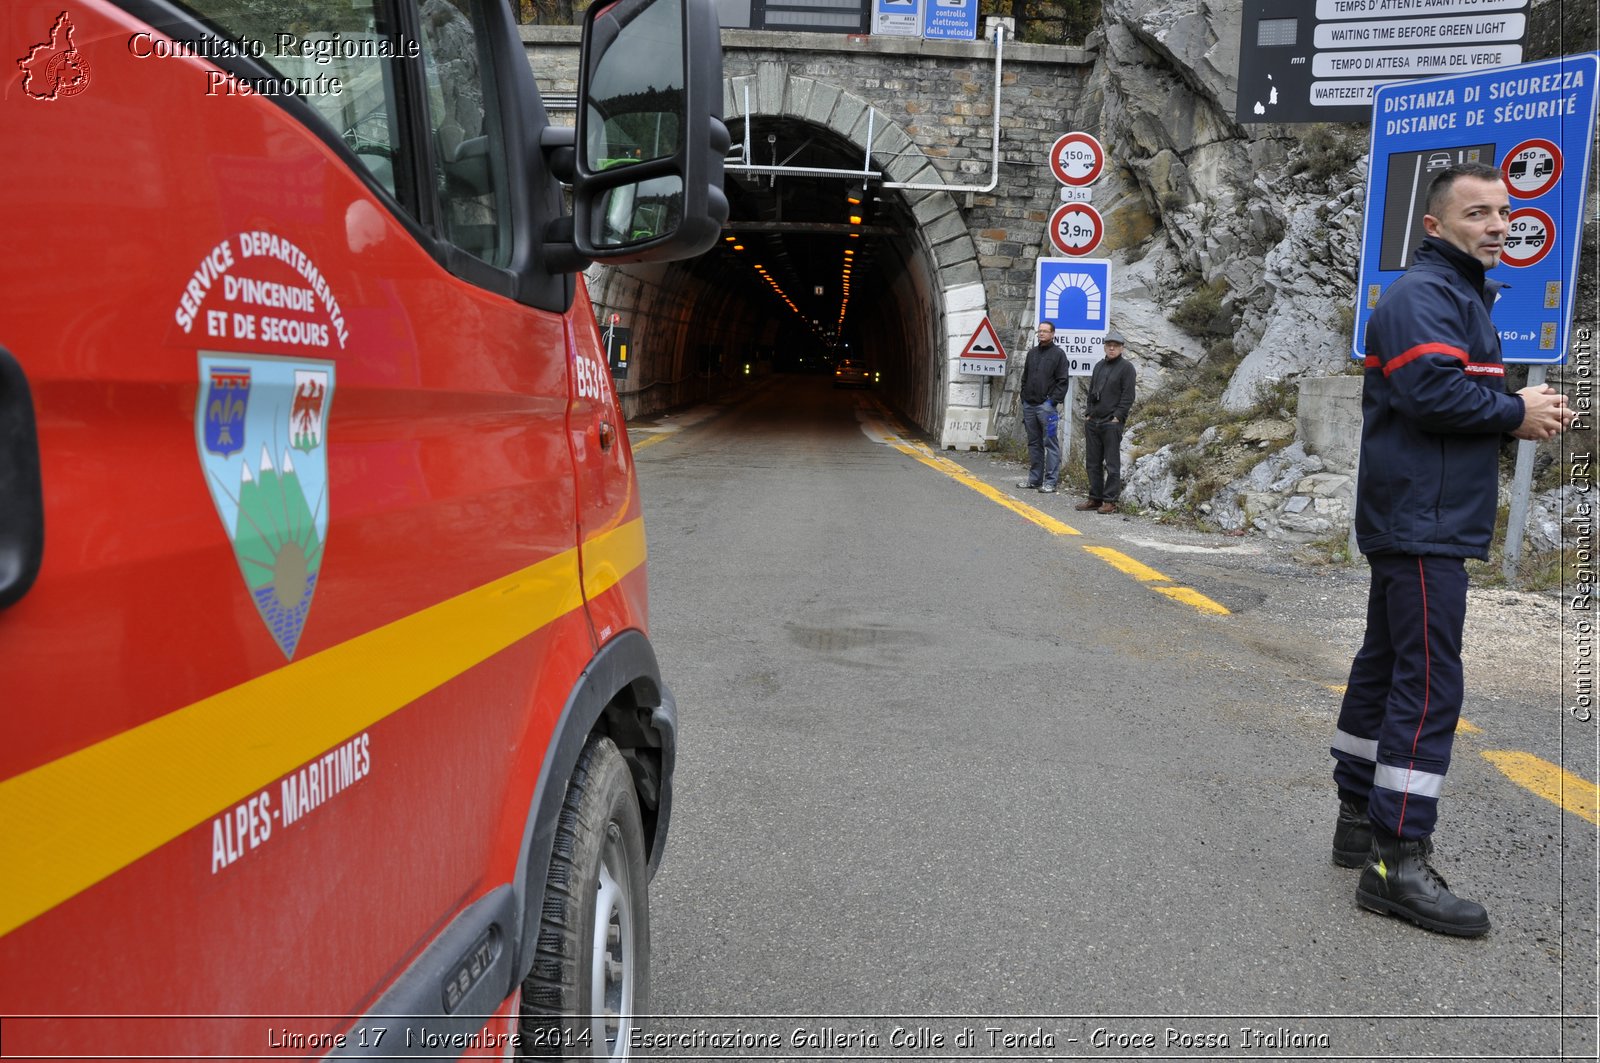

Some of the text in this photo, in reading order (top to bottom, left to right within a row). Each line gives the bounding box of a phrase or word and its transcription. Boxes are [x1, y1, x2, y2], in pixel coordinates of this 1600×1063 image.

[1335, 1, 1366, 12] TEMPS
[936, 10, 966, 18] controllo
[932, 18, 968, 27] elettronico
[1332, 22, 1506, 40] WAITING TIME BEFORE GREEN LIGHT
[1290, 56, 1306, 64] mn
[1331, 53, 1502, 70] TEMPO DI ATTESA PRIMA DEL VERDE
[1316, 87, 1373, 98] WARTEZEIT Z
[1384, 70, 1584, 113] DISTANZA DI SICUREZZA
[1386, 94, 1577, 136] DISTANCE DE SÉCURITÉ
[1520, 152, 1536, 160] 150
[176, 231, 349, 350] SERVICE DEPARTEMENTAL
[224, 274, 315, 313] D'INCENDIE
[207, 310, 330, 348] ET DE SECOURS
[1504, 332, 1518, 340] 50
[1066, 346, 1093, 354] TENDE
